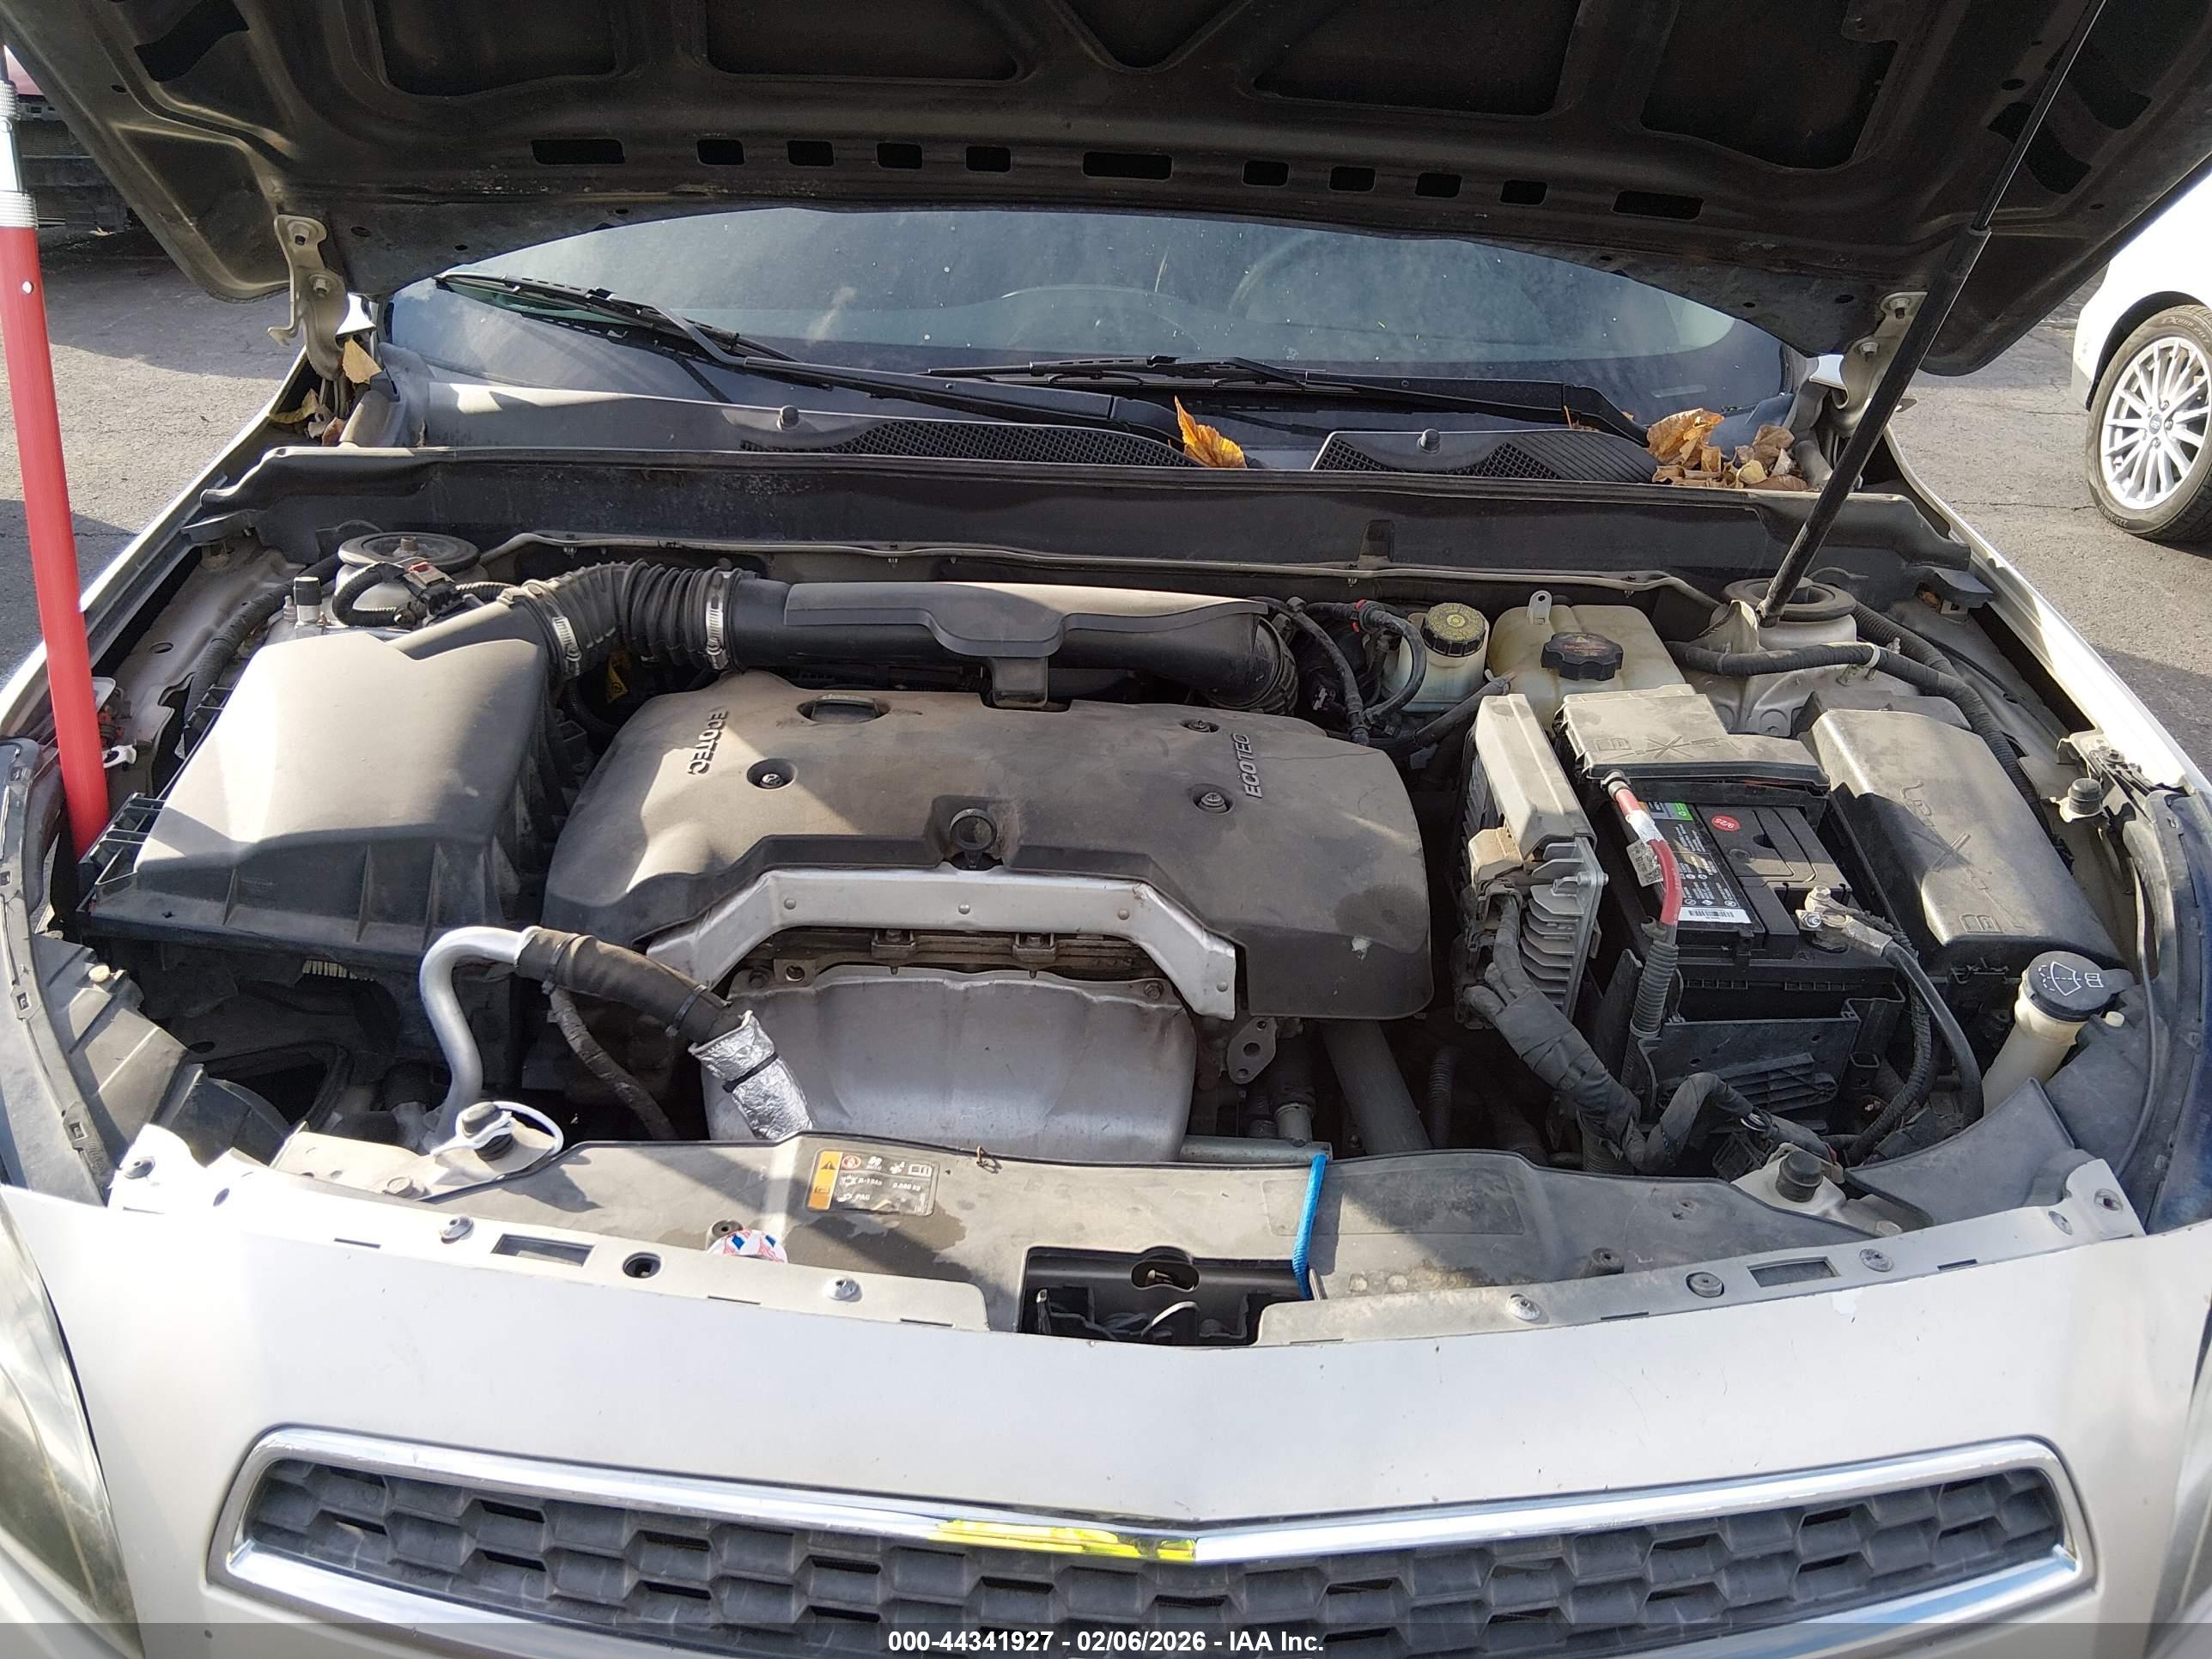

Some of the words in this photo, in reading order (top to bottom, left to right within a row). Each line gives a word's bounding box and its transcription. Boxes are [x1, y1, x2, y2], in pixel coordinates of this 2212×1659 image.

[686, 707, 729, 776] ECOTEC
[1231, 732, 1263, 799] ECOTEC
[1714, 817, 1735, 830] 9/25
